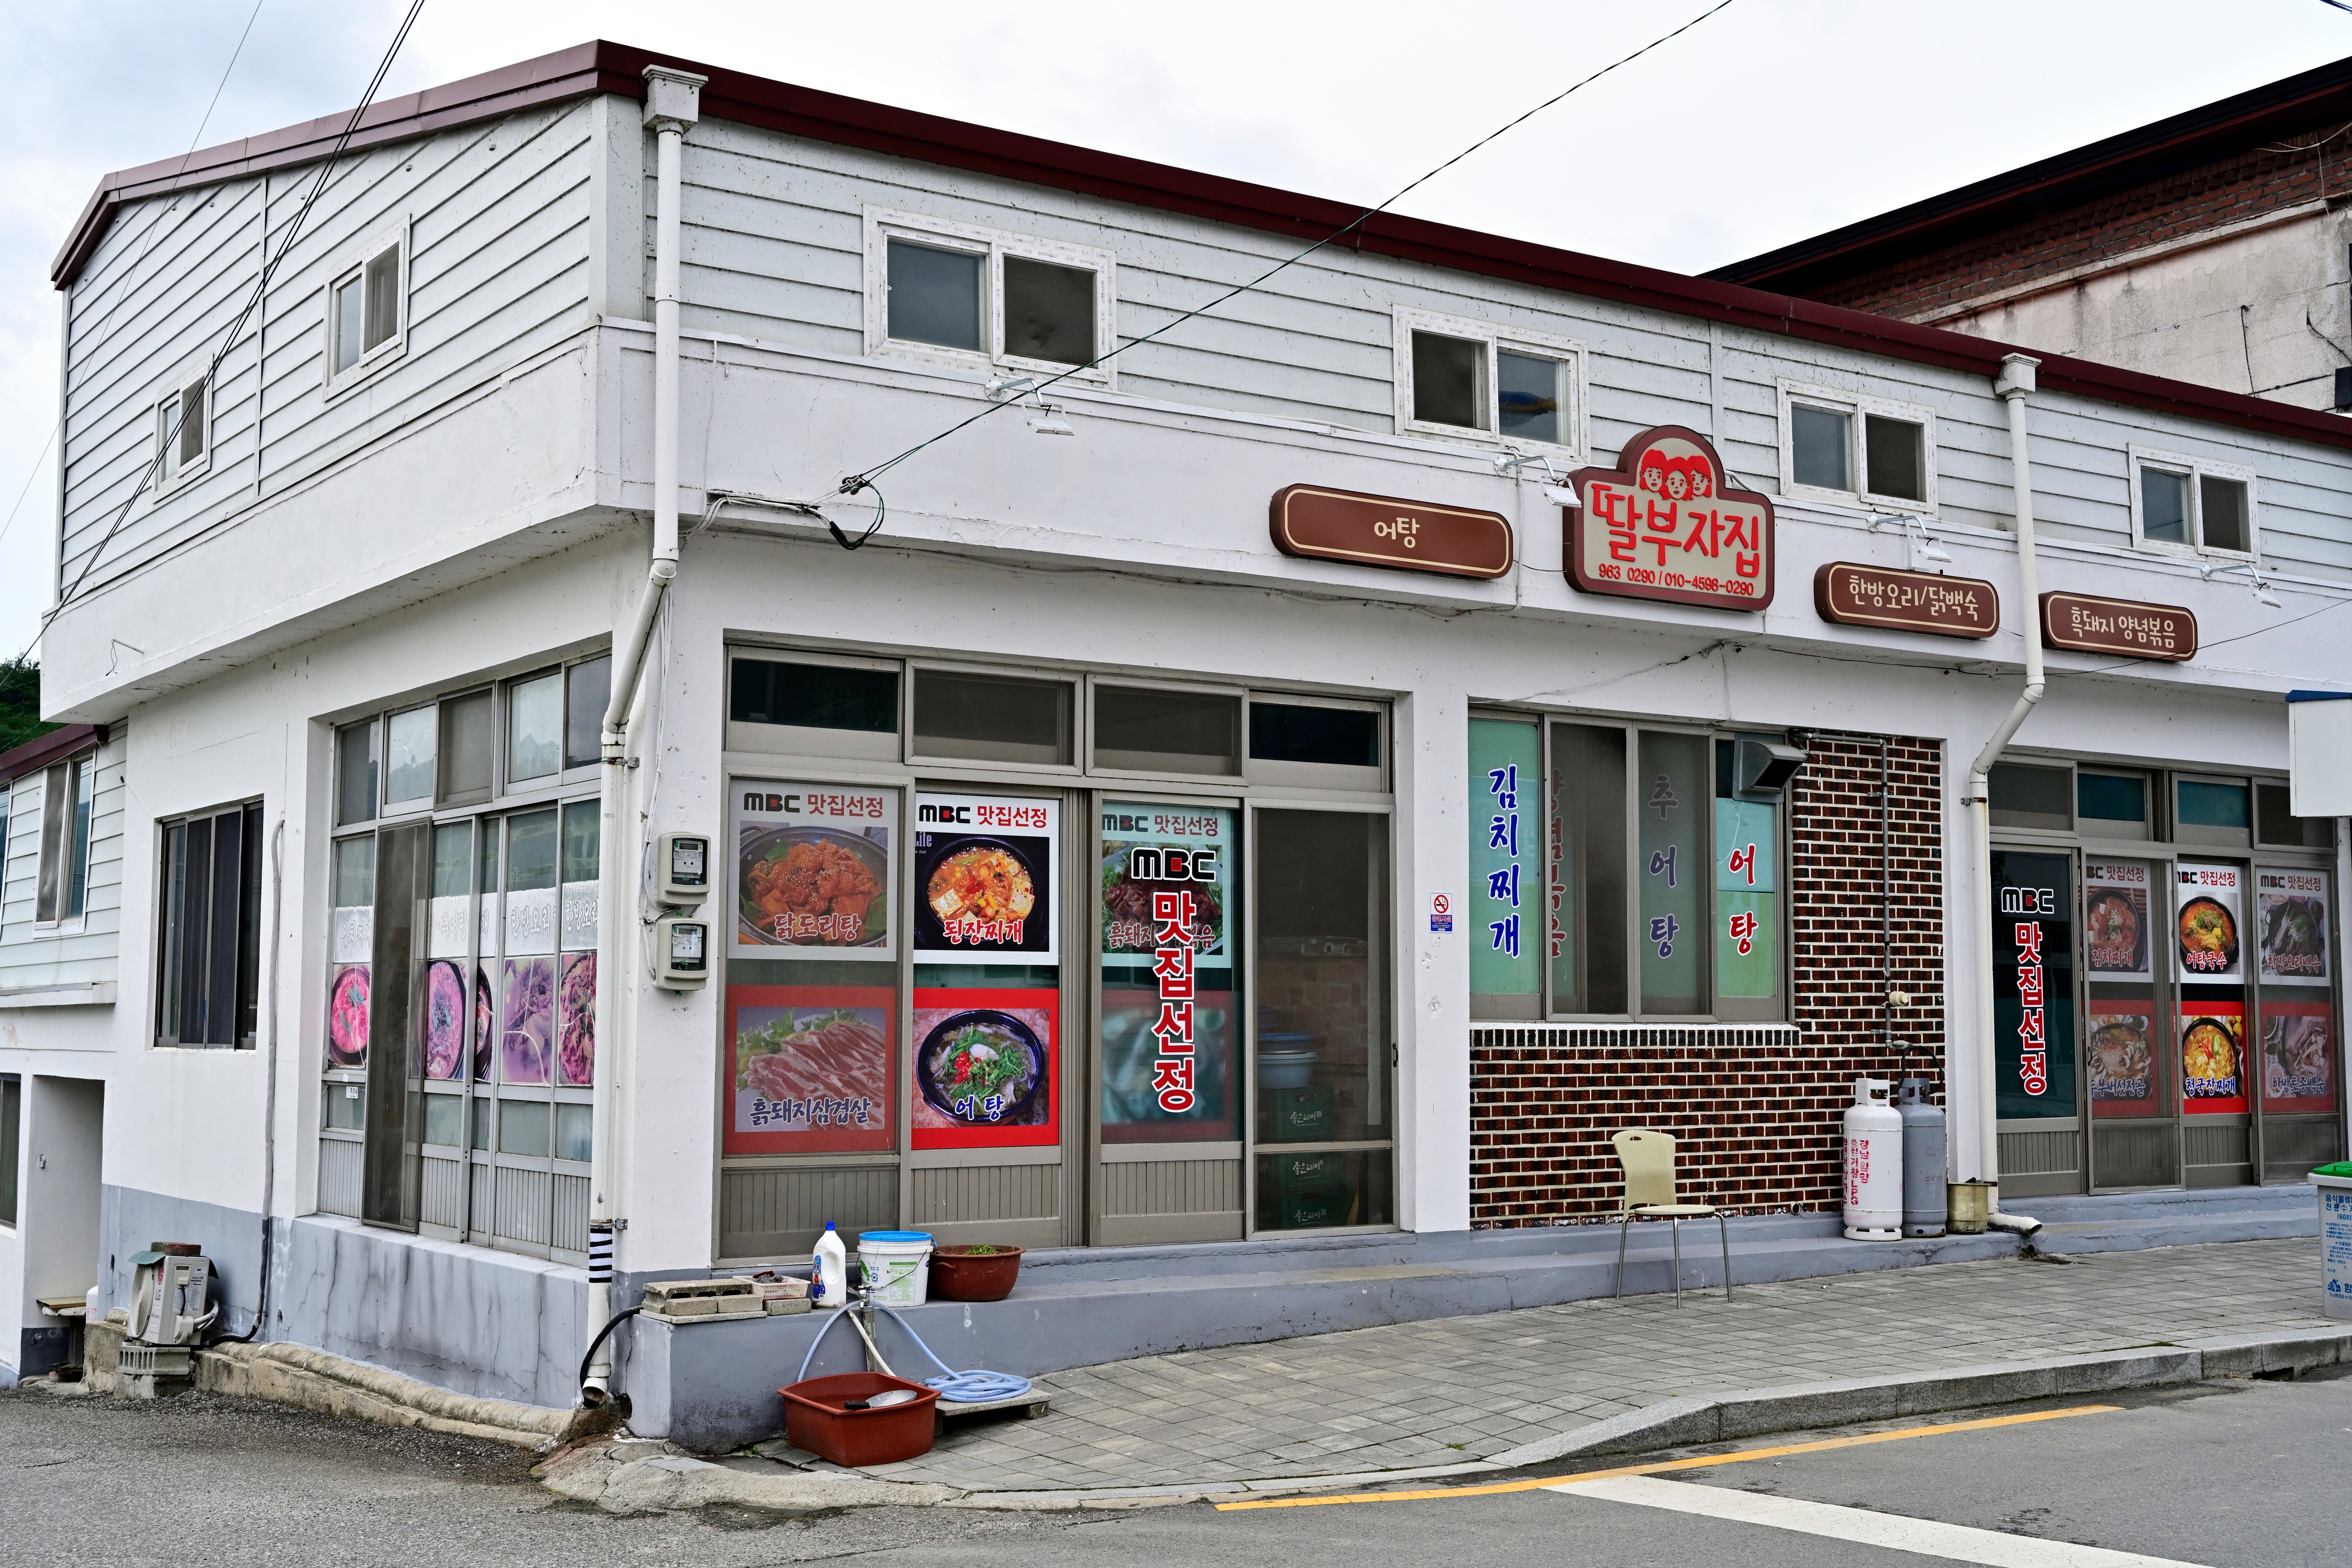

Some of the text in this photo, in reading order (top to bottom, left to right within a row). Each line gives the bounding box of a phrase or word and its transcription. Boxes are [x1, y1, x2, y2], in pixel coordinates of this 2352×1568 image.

[1374, 517, 1420, 549] 어탕
[1591, 483, 1760, 578] 딸부자집
[1598, 564, 1621, 579] 963
[1848, 575, 1979, 622] 한방오리/닭백숙
[2071, 606, 2176, 648] 흑돼지 양념볶음
[744, 792, 884, 818] MBC 맛집선정
[919, 804, 1047, 828] MBC 맛집선정
[1102, 814, 1218, 837] MBC 맛집선정
[1131, 846, 1216, 882] MBC
[1487, 764, 1521, 959] 김치찌개
[1648, 773, 1680, 960] 추어탕
[2086, 866, 2144, 882] BC 맛집선정
[2200, 871, 2235, 887] 맛집선정
[2261, 875, 2321, 891] MBC 맛집선정
[1728, 843, 1758, 957] 어탕
[2002, 887, 2054, 914] MBC
[342, 919, 372, 947] 김치찌개
[510, 903, 556, 938] 한방오리
[774, 912, 862, 941] 닭도리탕
[943, 918, 1023, 945] 된장찌개
[2091, 948, 2133, 967] 김치찌개
[2186, 951, 2227, 970] 어탕국수
[2267, 953, 2321, 973] 한방오리백숙
[1152, 891, 1196, 1113] 맛집선정
[2015, 922, 2047, 1095] 맛집선정
[2185, 1076, 2236, 1096] 청국장찌개
[2272, 1075, 2326, 1094] 한방토종백숙
[1290, 1111, 1316, 1124] 좋은데이
[1293, 1161, 1320, 1175] 좋은데이
[1859, 1139, 1869, 1184] 경남함양
[2326, 1194, 2352, 1204] 음식물류
[1295, 1210, 1320, 1222] 좋은데이
[155, 1289, 161, 1301] LG
